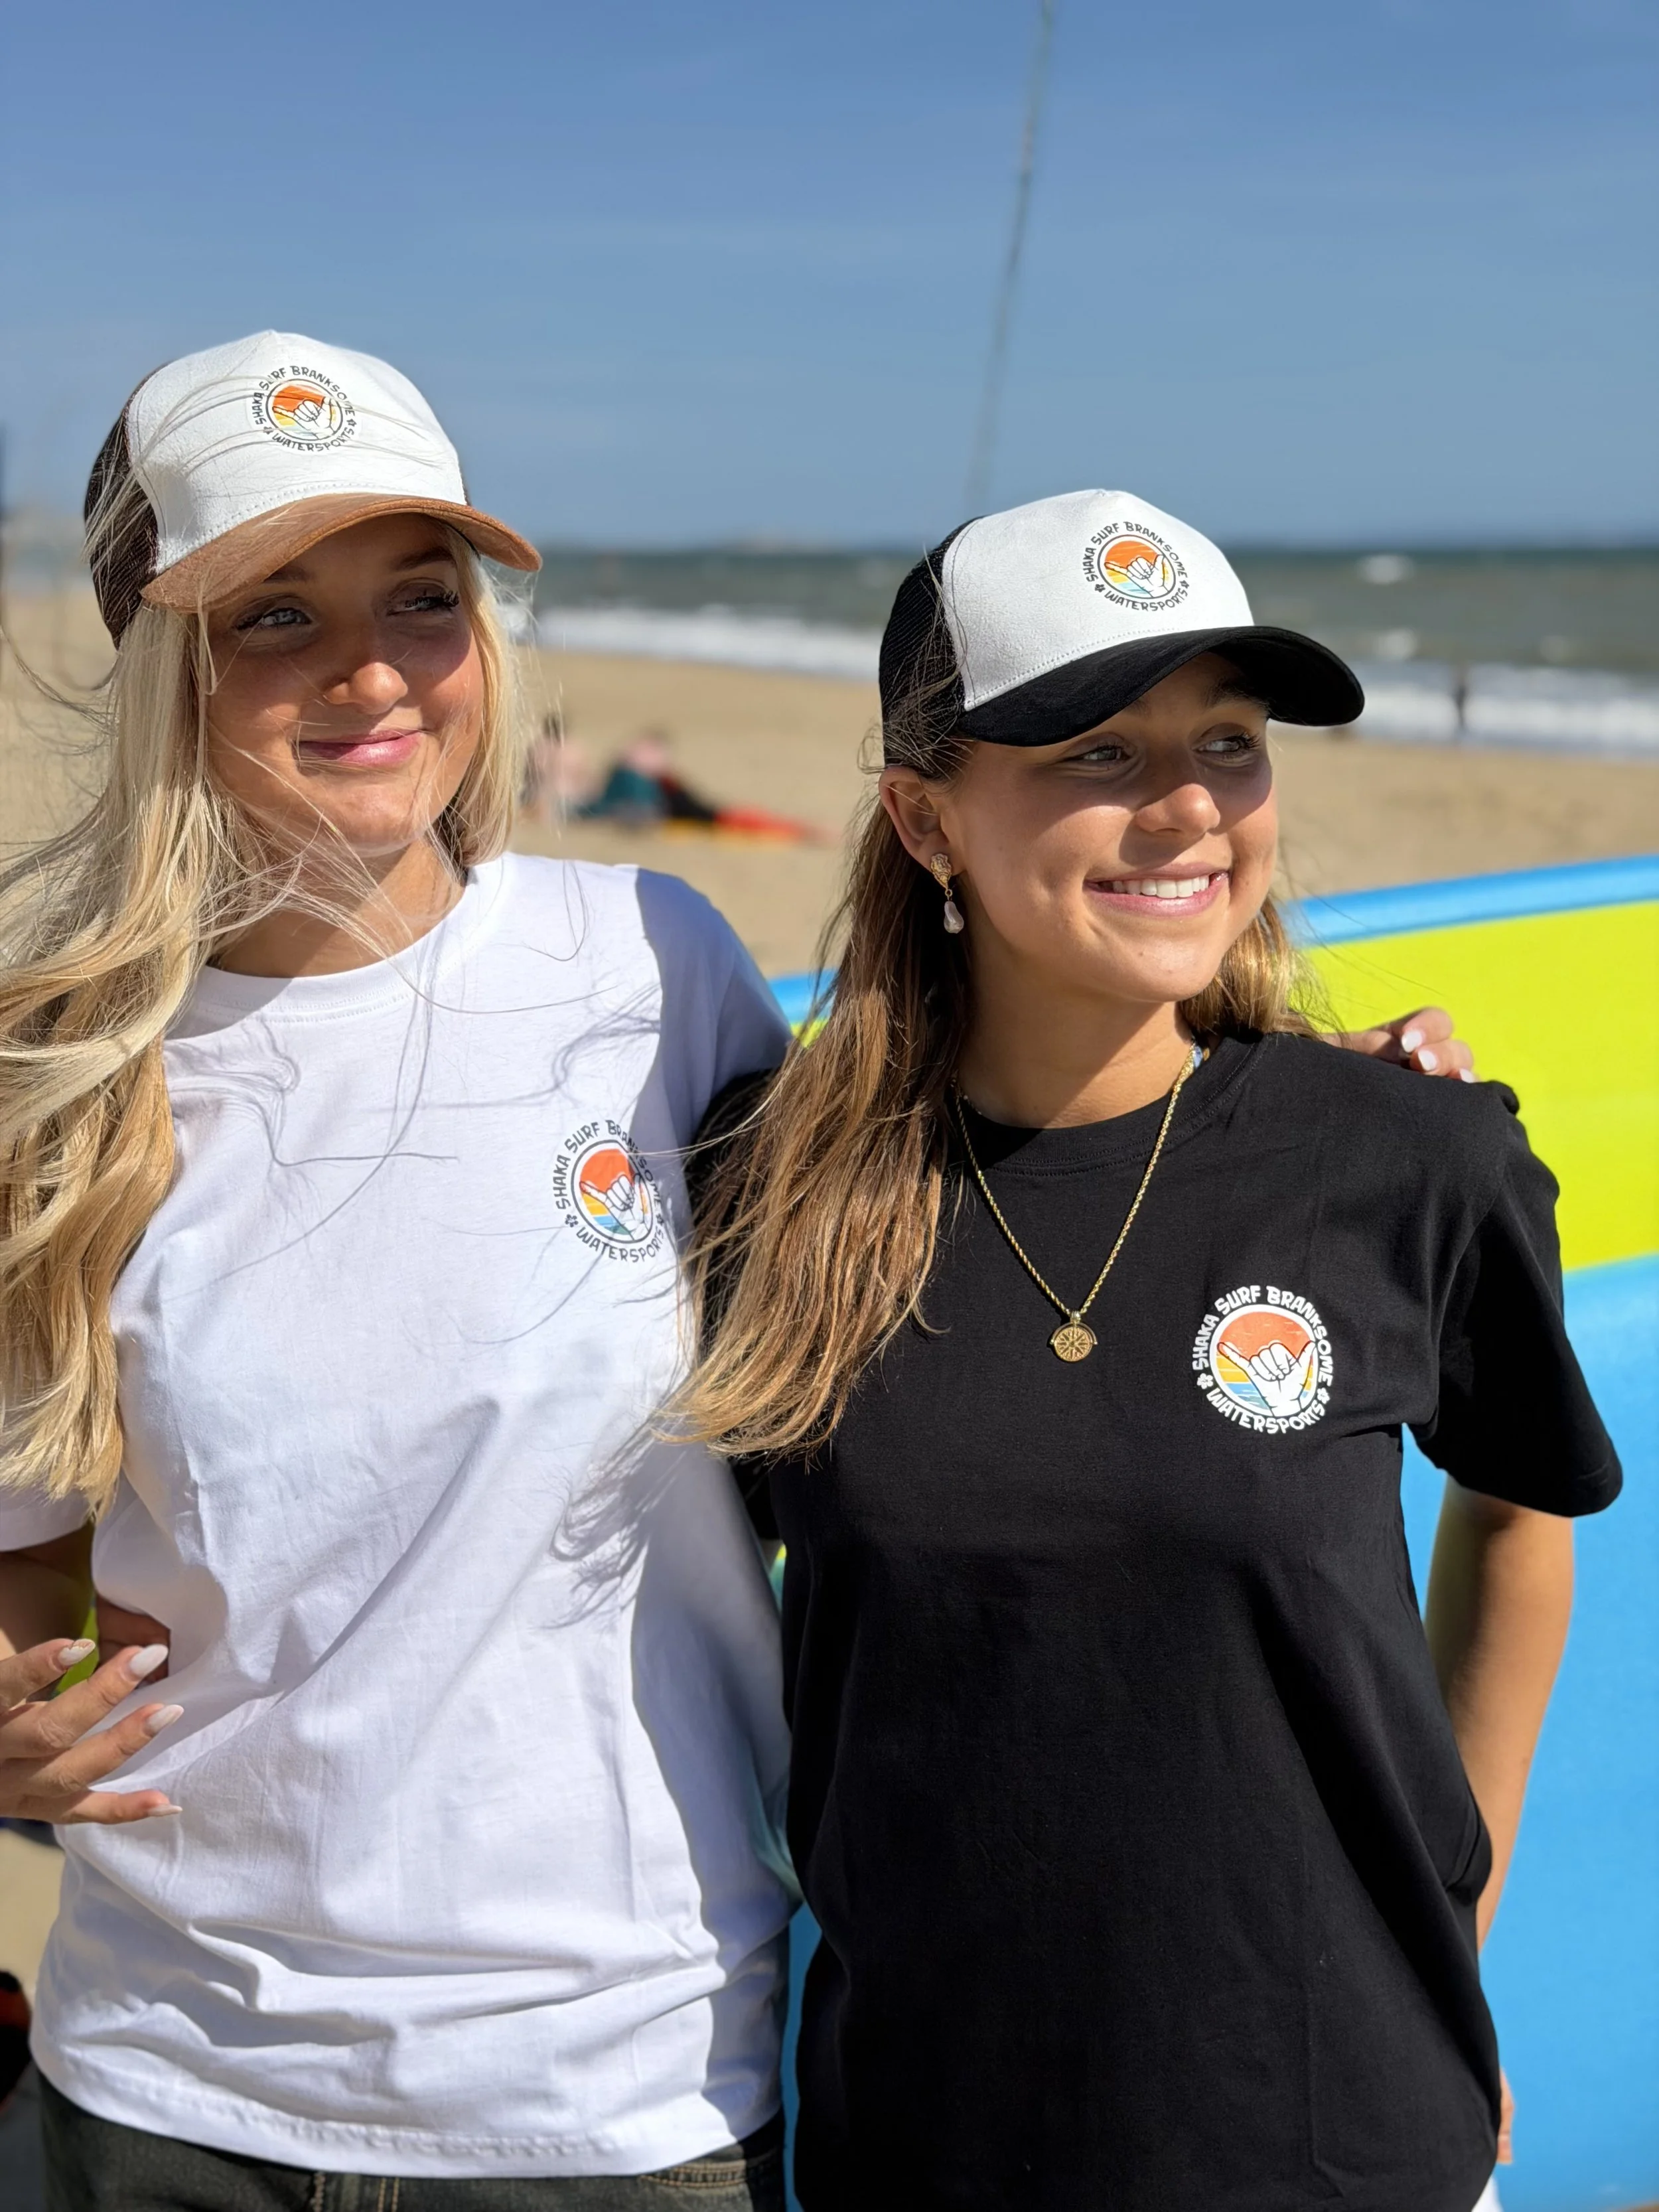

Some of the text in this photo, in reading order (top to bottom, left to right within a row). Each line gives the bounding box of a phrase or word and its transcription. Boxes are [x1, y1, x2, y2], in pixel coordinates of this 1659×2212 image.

[259, 367, 287, 390] SURF
[252, 392, 267, 425] SHAKA
[271, 427, 354, 452] WATERSPORTS
[1082, 521, 1189, 582] SHAKA SURF BRANKSOME
[1104, 587, 1189, 612] WATERSPORTS
[553, 1154, 571, 1210] SHAKA
[564, 1122, 600, 1153] SURF
[576, 1226, 664, 1263] WATERSPORTS
[1192, 1285, 1334, 1387] SHAKA SURF BRANKSOME
[1206, 1388, 1326, 1435] WATERSPORTS
